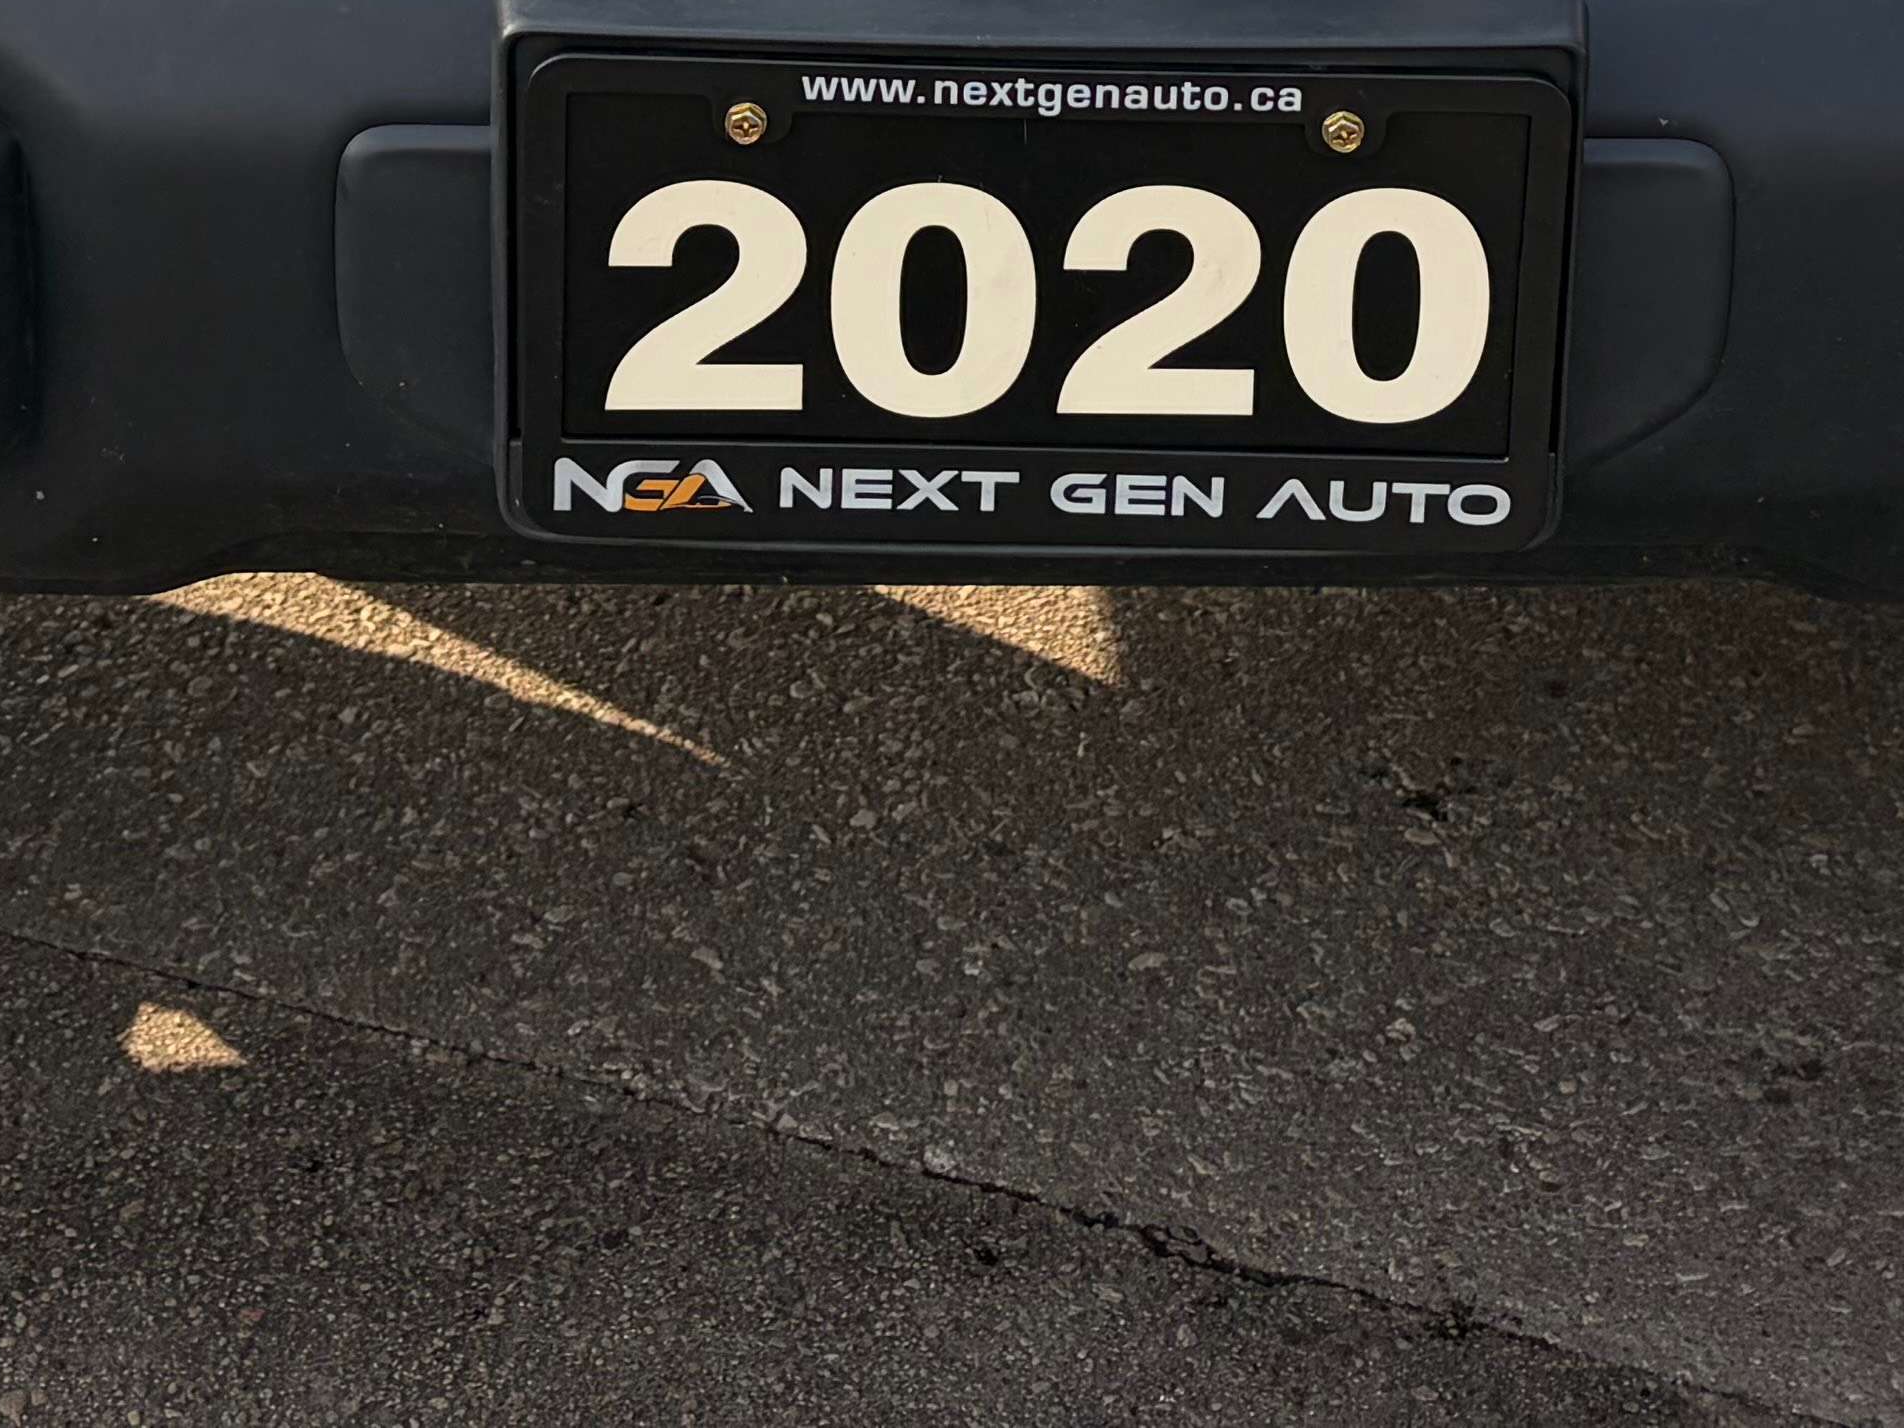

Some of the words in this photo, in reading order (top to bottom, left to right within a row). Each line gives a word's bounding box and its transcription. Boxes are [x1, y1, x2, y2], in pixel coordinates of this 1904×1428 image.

[801, 74, 1303, 117] www.nextgenauto.ca
[605, 178, 1490, 424] 2020
[552, 456, 754, 513] NGA
[778, 466, 1020, 511] NEXT
[1049, 473, 1226, 519] GEN
[1255, 478, 1512, 526] AUTO
